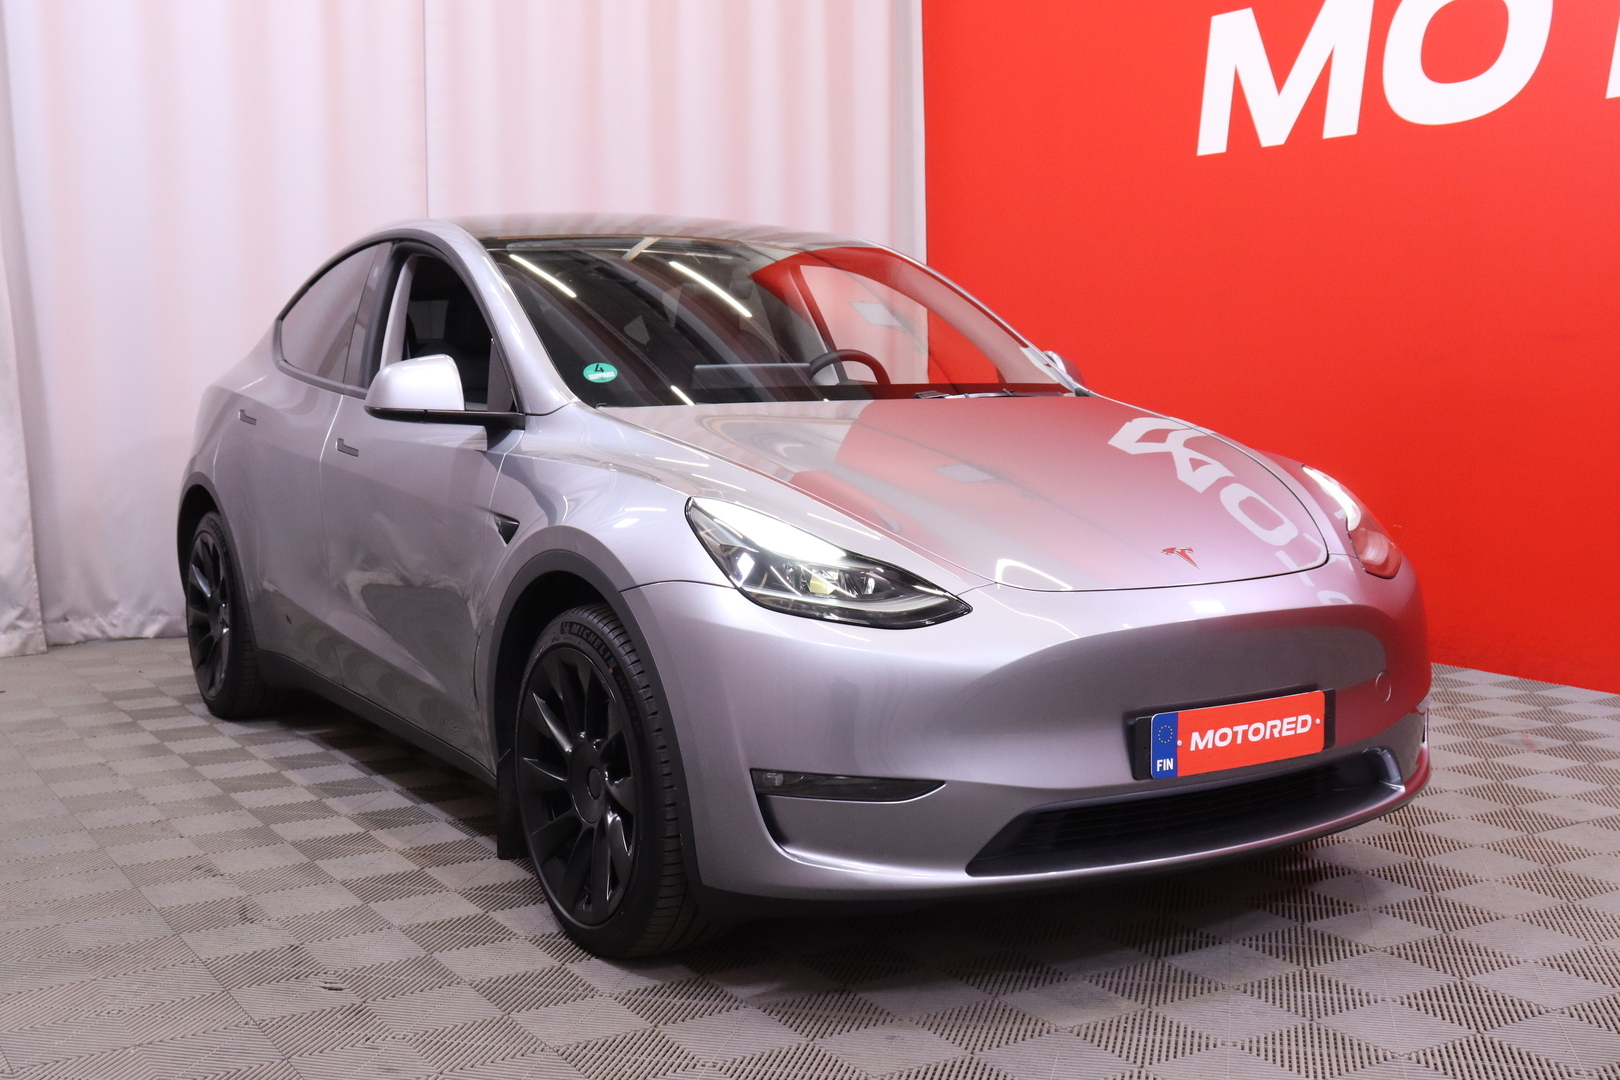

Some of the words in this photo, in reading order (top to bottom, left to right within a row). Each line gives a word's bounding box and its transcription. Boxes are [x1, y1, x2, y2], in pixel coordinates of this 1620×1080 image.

[1197, 0, 1620, 156] MO
[594, 363, 604, 372] 4
[570, 623, 618, 669] MICHELIN
[1190, 714, 1312, 751] MOTORED
[1156, 758, 1174, 772] FIN
